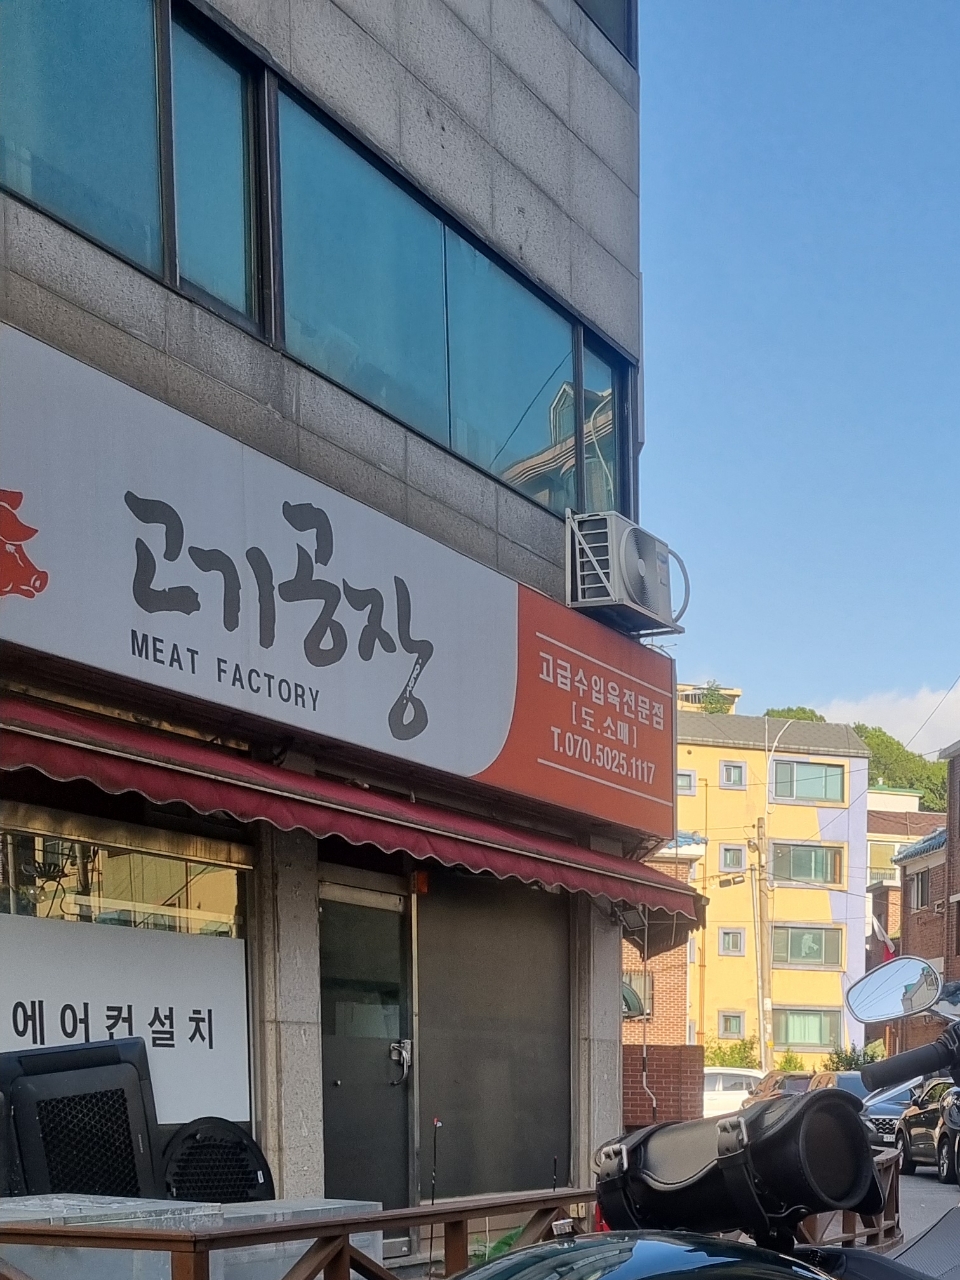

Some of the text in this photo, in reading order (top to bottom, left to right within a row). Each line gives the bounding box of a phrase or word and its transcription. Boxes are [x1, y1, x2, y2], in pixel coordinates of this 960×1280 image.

[124, 490, 434, 741] 고기공장
[130, 628, 320, 712] MEAT FACTORY
[539, 651, 664, 731] 고급수입육전문점
[551, 726, 656, 785] T.070.5025.1117
